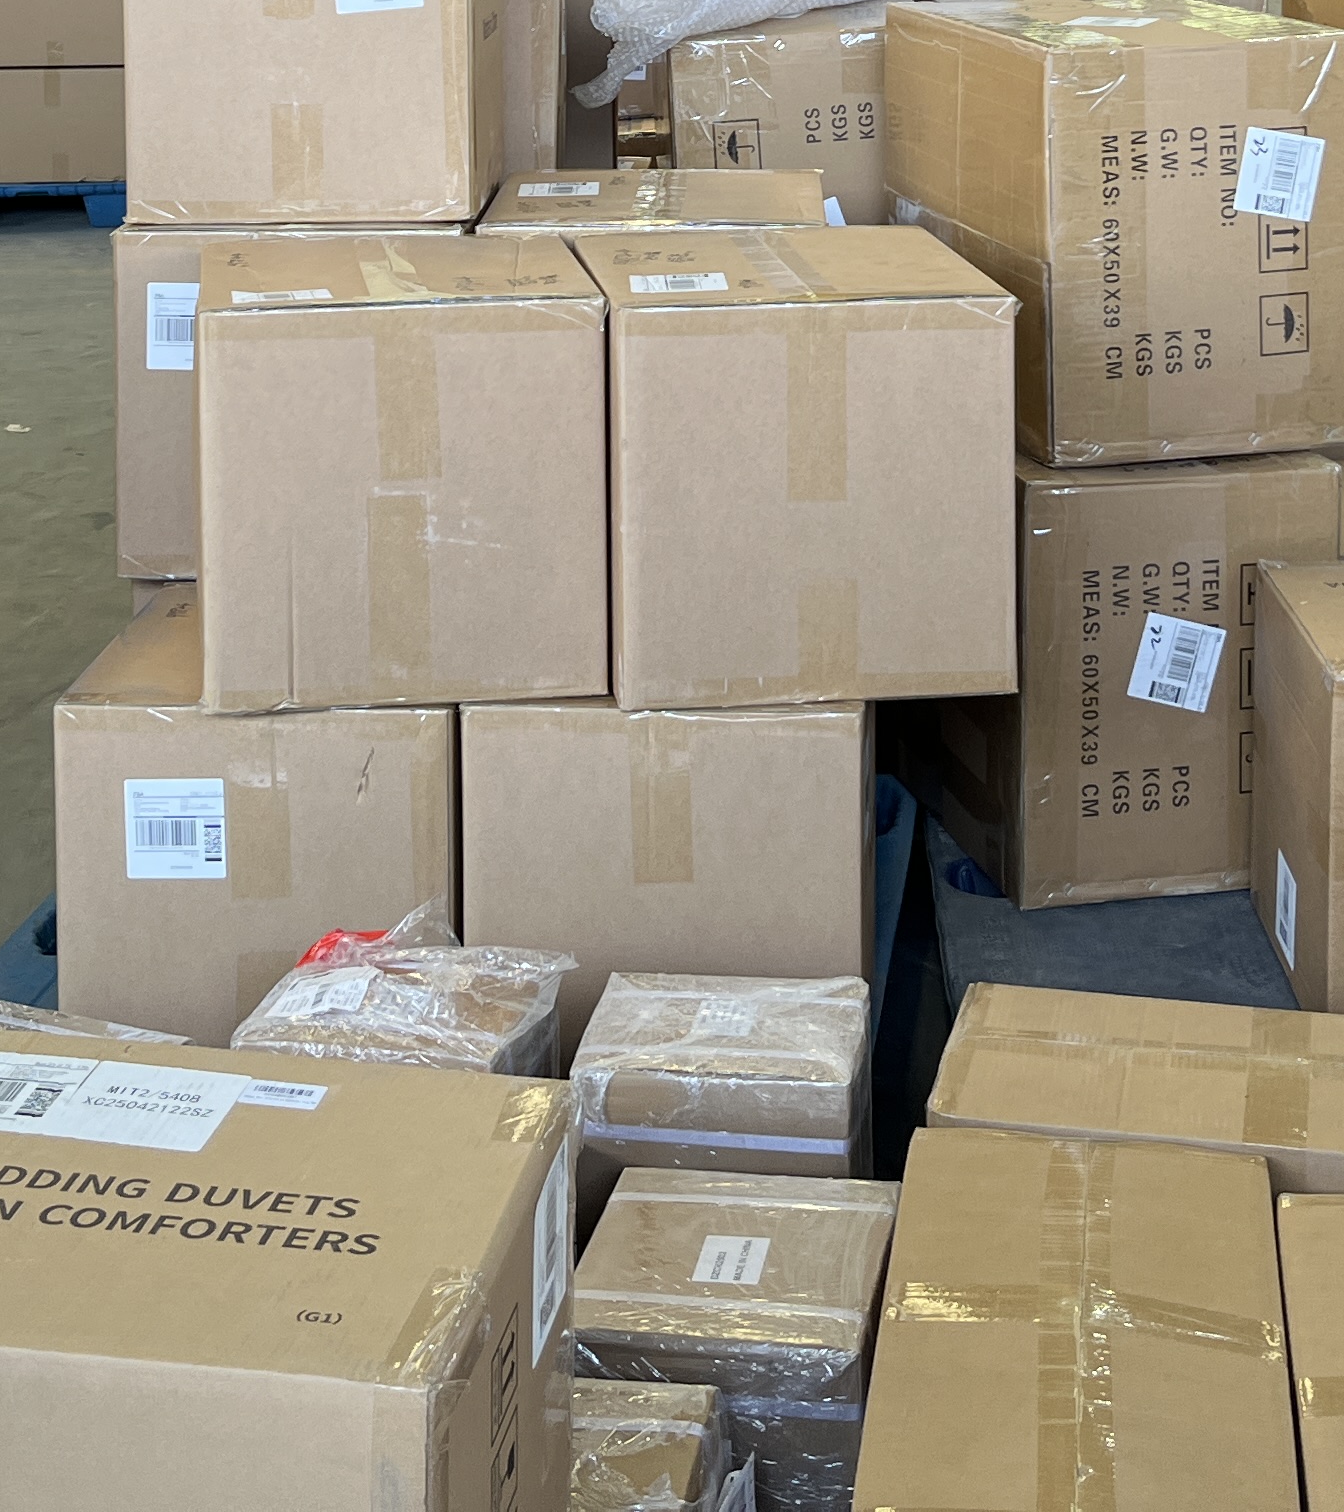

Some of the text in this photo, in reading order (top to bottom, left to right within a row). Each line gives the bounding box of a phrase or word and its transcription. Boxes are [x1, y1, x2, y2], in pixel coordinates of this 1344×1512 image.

[804, 107, 822, 144] PCS
[830, 104, 849, 142] KGS
[857, 101, 875, 140] KGS
[1219, 124, 1237, 176] ITEM
[1101, 135, 1123, 380] MEAS: 60X50X39 CM
[1130, 130, 1153, 377] N.W: KGS
[1160, 128, 1183, 375] G.W: KGS
[1190, 126, 1212, 370] QTY: PCS
[1202, 559, 1220, 612] ITEM
[1081, 570, 1100, 818] MEAS: 60X50X39 CM
[1112, 565, 1130, 815] N.W: KGS
[1142, 563, 1160, 813] G.W: KGS
[1172, 561, 1190, 808] QTY: PCS
[37, 1203, 383, 1257] COMFORTERS
[164, 1181, 363, 1220] DUVETS
[294, 1309, 344, 1326] (G1)
